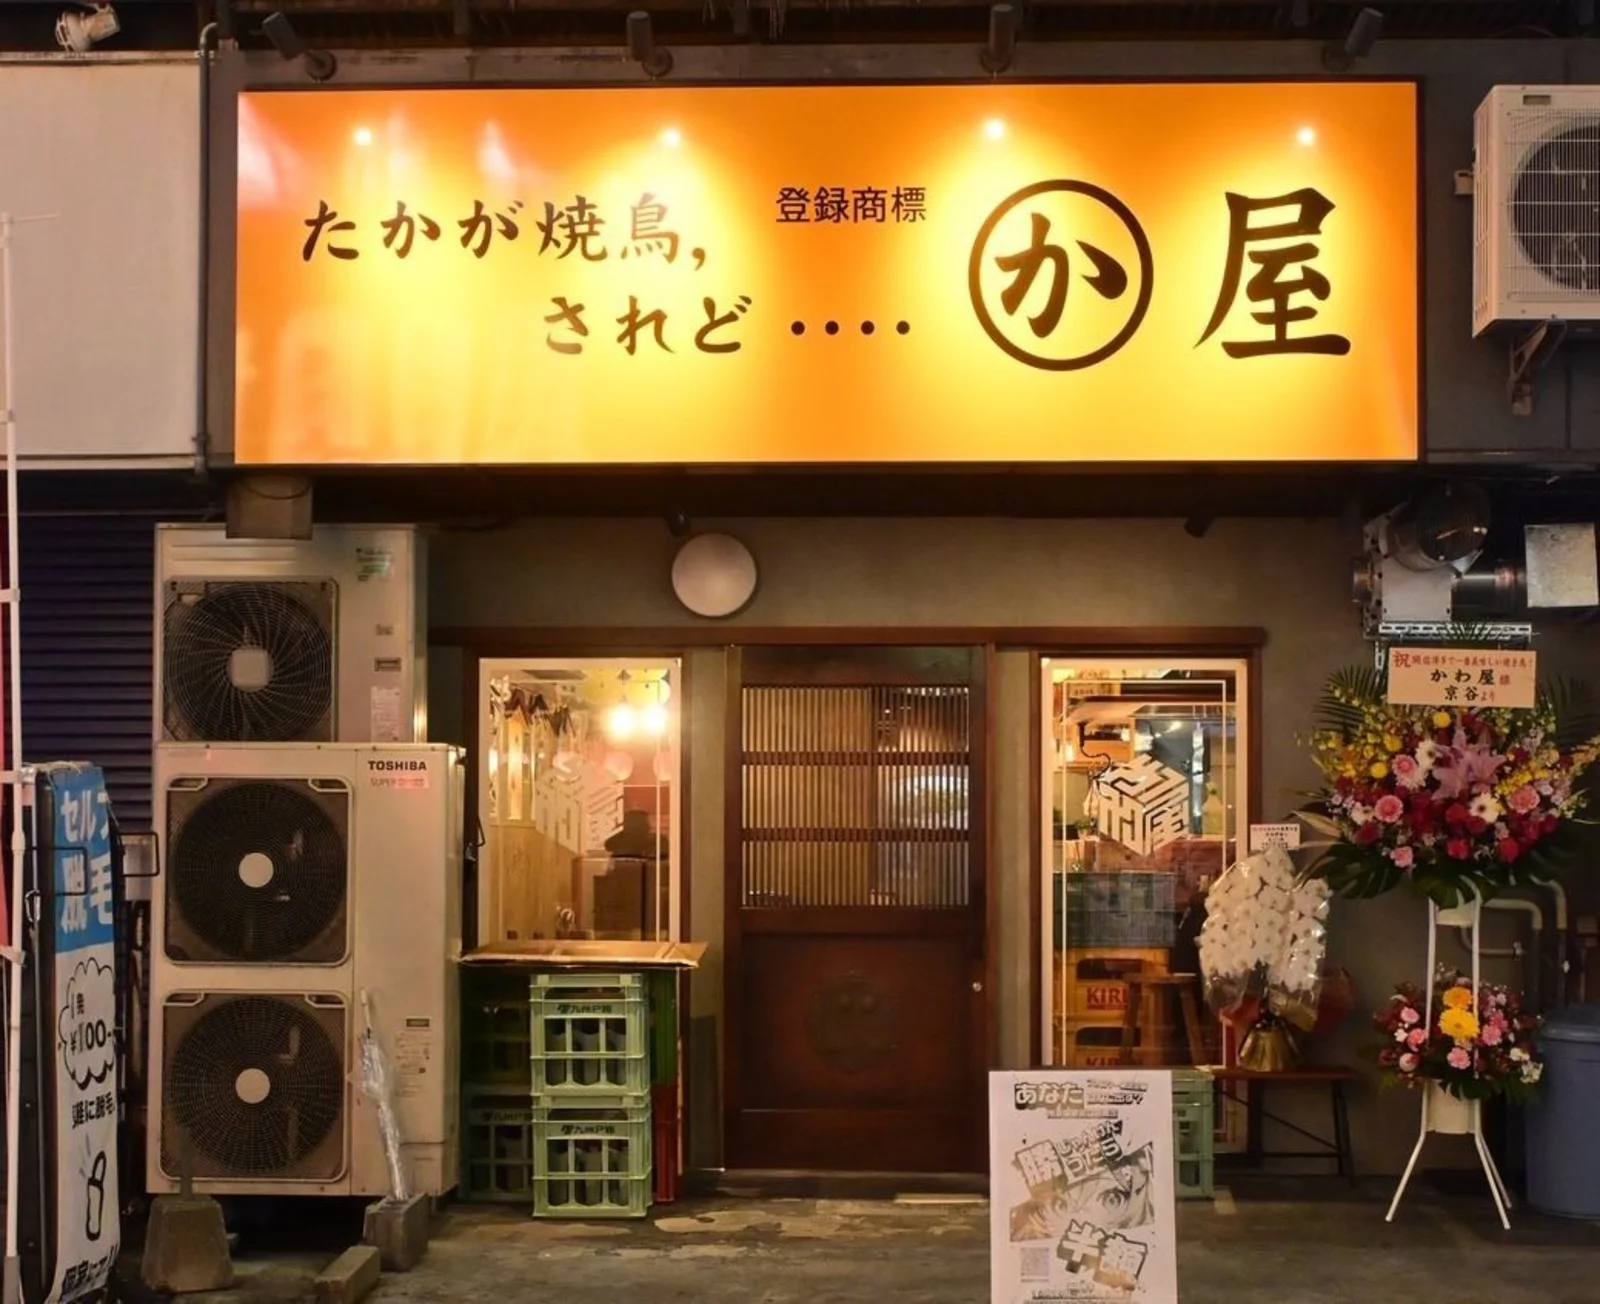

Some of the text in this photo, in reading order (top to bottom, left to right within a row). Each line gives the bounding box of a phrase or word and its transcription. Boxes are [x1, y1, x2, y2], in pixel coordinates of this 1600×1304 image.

[776, 187, 927, 223] 登録商標
[1393, 650, 1412, 668] 祝
[1430, 669, 1495, 686] かわ屋
[1444, 685, 1479, 701] 京谷
[368, 761, 427, 771] TOSHIBA
[1087, 987, 1129, 1004] KIRI
[1015, 1082, 1085, 1108] あなた
